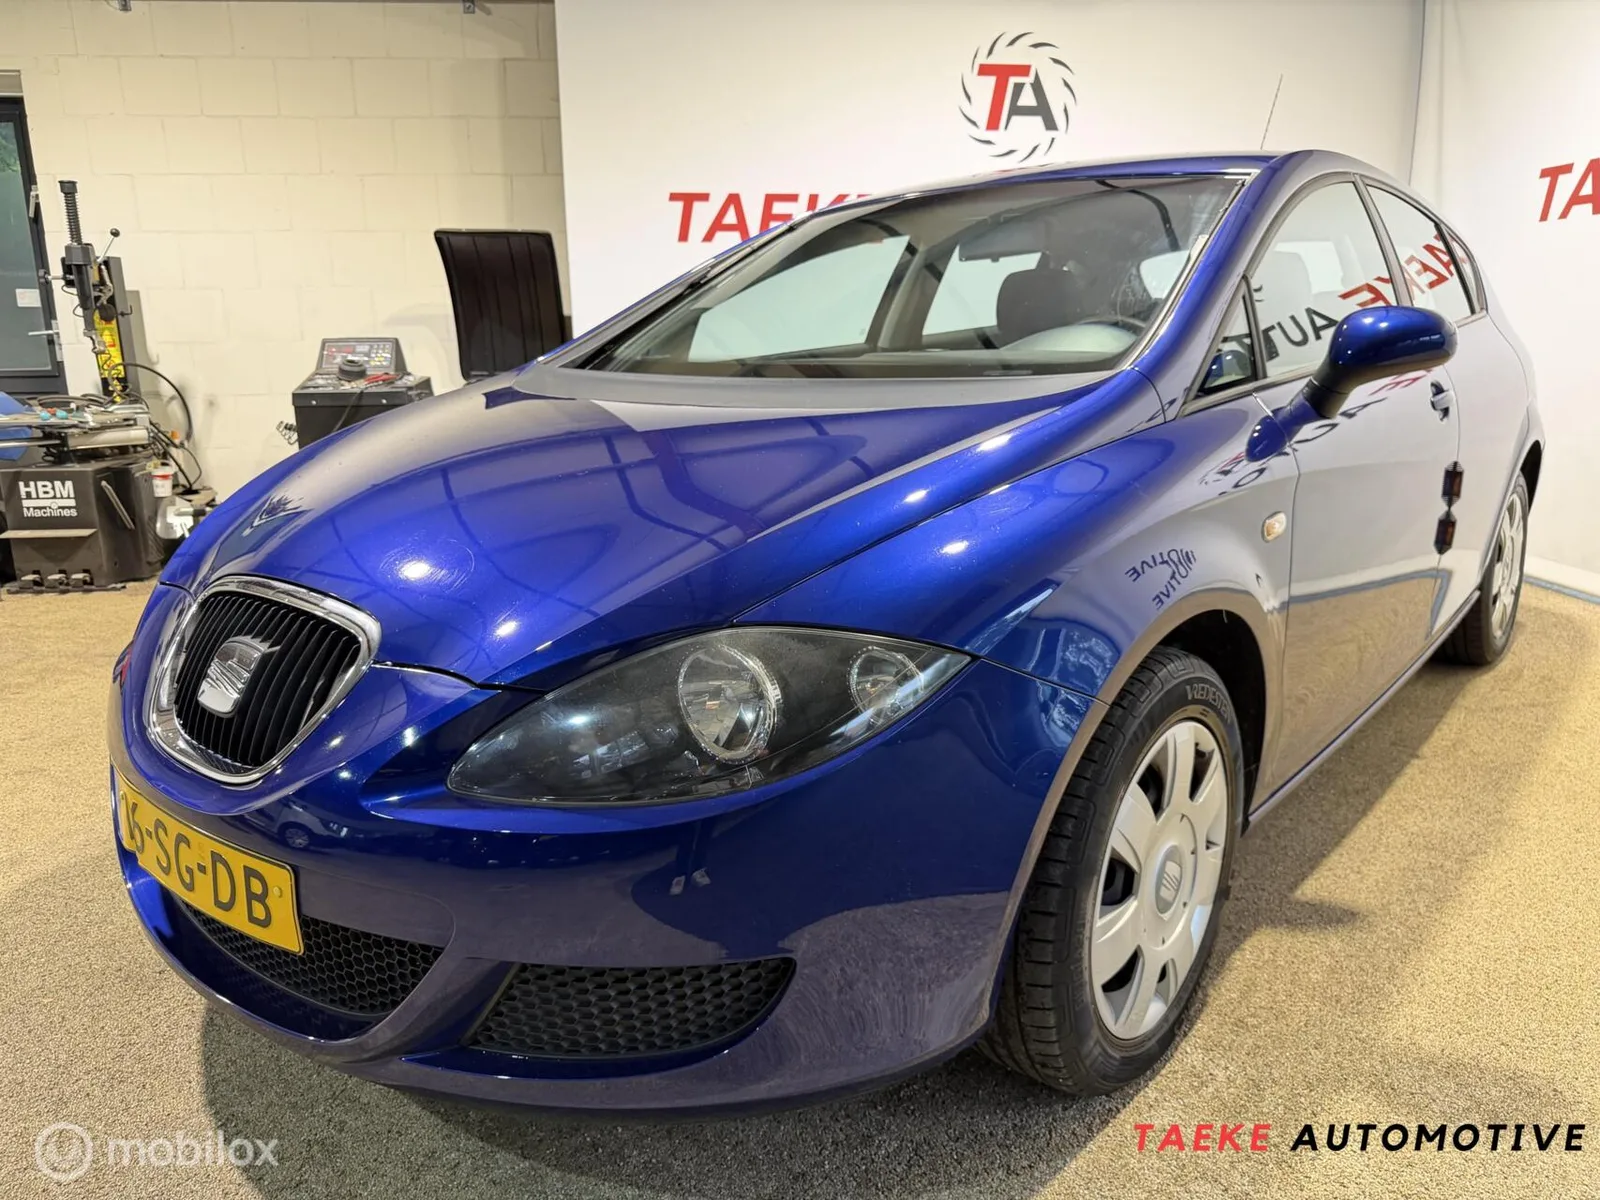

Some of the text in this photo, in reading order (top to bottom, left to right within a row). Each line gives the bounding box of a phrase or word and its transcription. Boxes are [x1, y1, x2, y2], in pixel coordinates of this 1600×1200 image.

[977, 63, 1059, 131] TA
[668, 192, 872, 243] TAE
[18, 480, 75, 499] HBM
[23, 507, 78, 518] Machines
